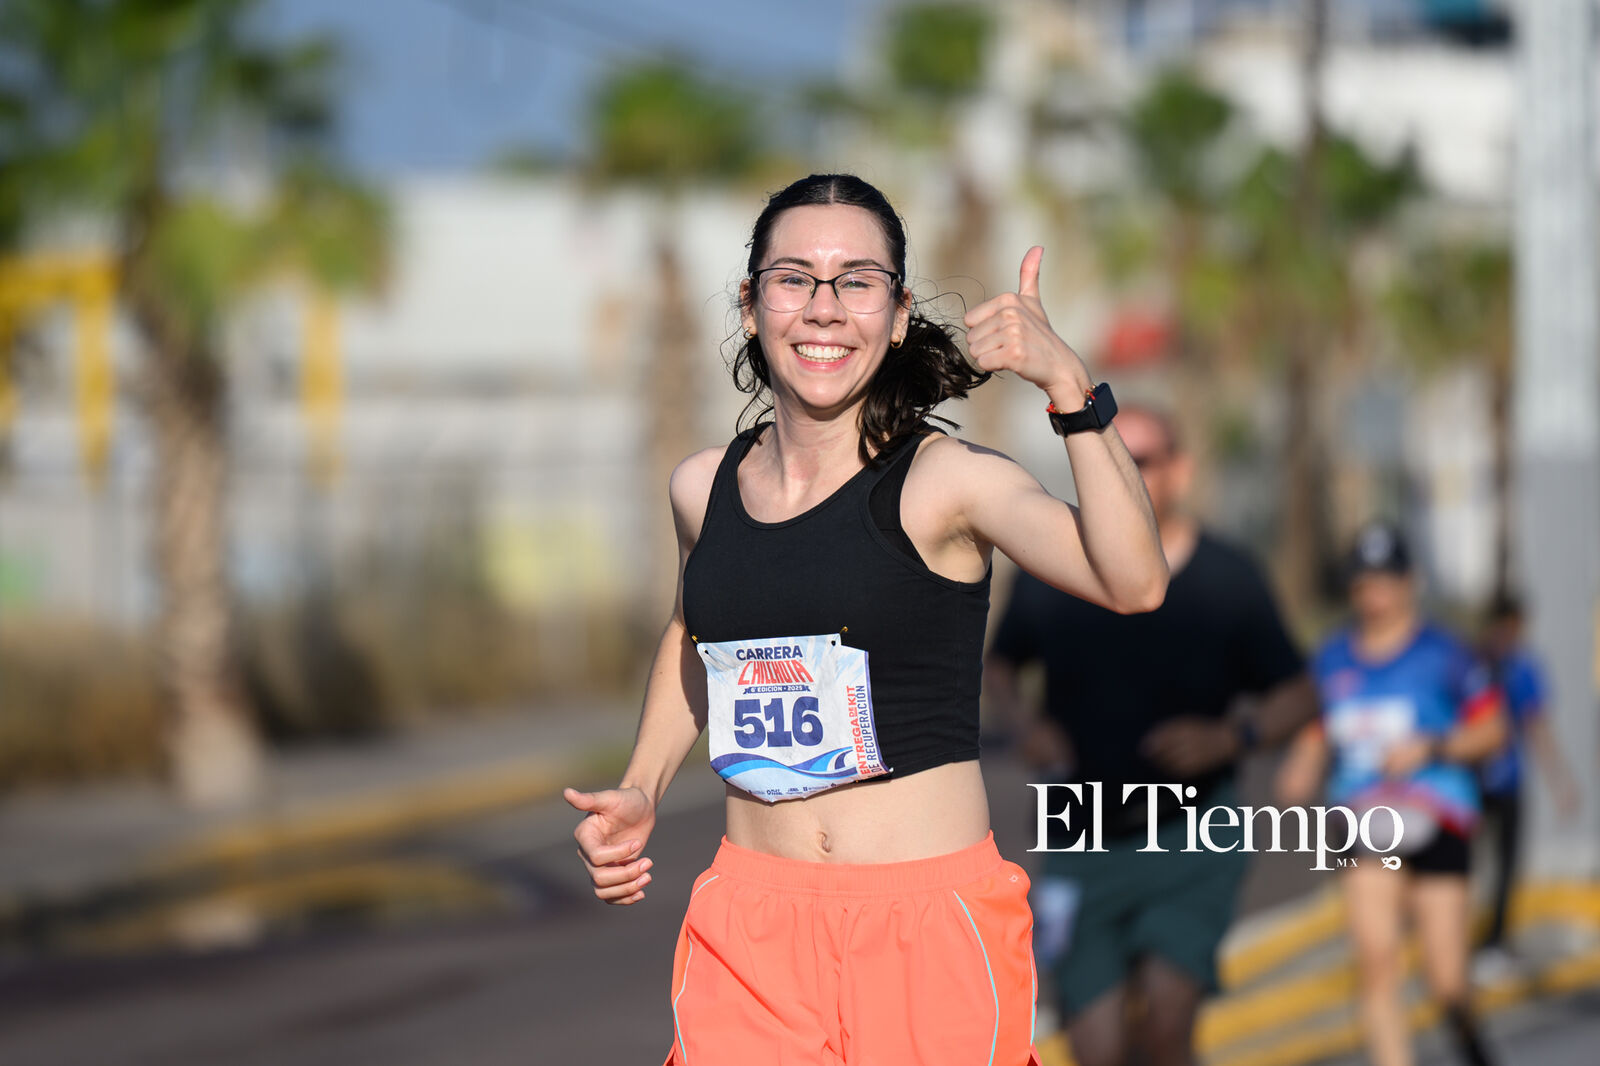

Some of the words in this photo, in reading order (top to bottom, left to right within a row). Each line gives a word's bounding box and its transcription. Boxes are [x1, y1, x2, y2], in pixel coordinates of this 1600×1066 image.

[736, 645, 803, 660] CARRERA
[738, 659, 814, 685] CHILCHOTA
[846, 685, 857, 706] KIT
[734, 696, 824, 749] 516
[848, 706, 858, 717] DE
[855, 685, 877, 761] RECUPERACIÓN
[850, 718, 871, 775] ENTREGA
[868, 763, 882, 773] DE
